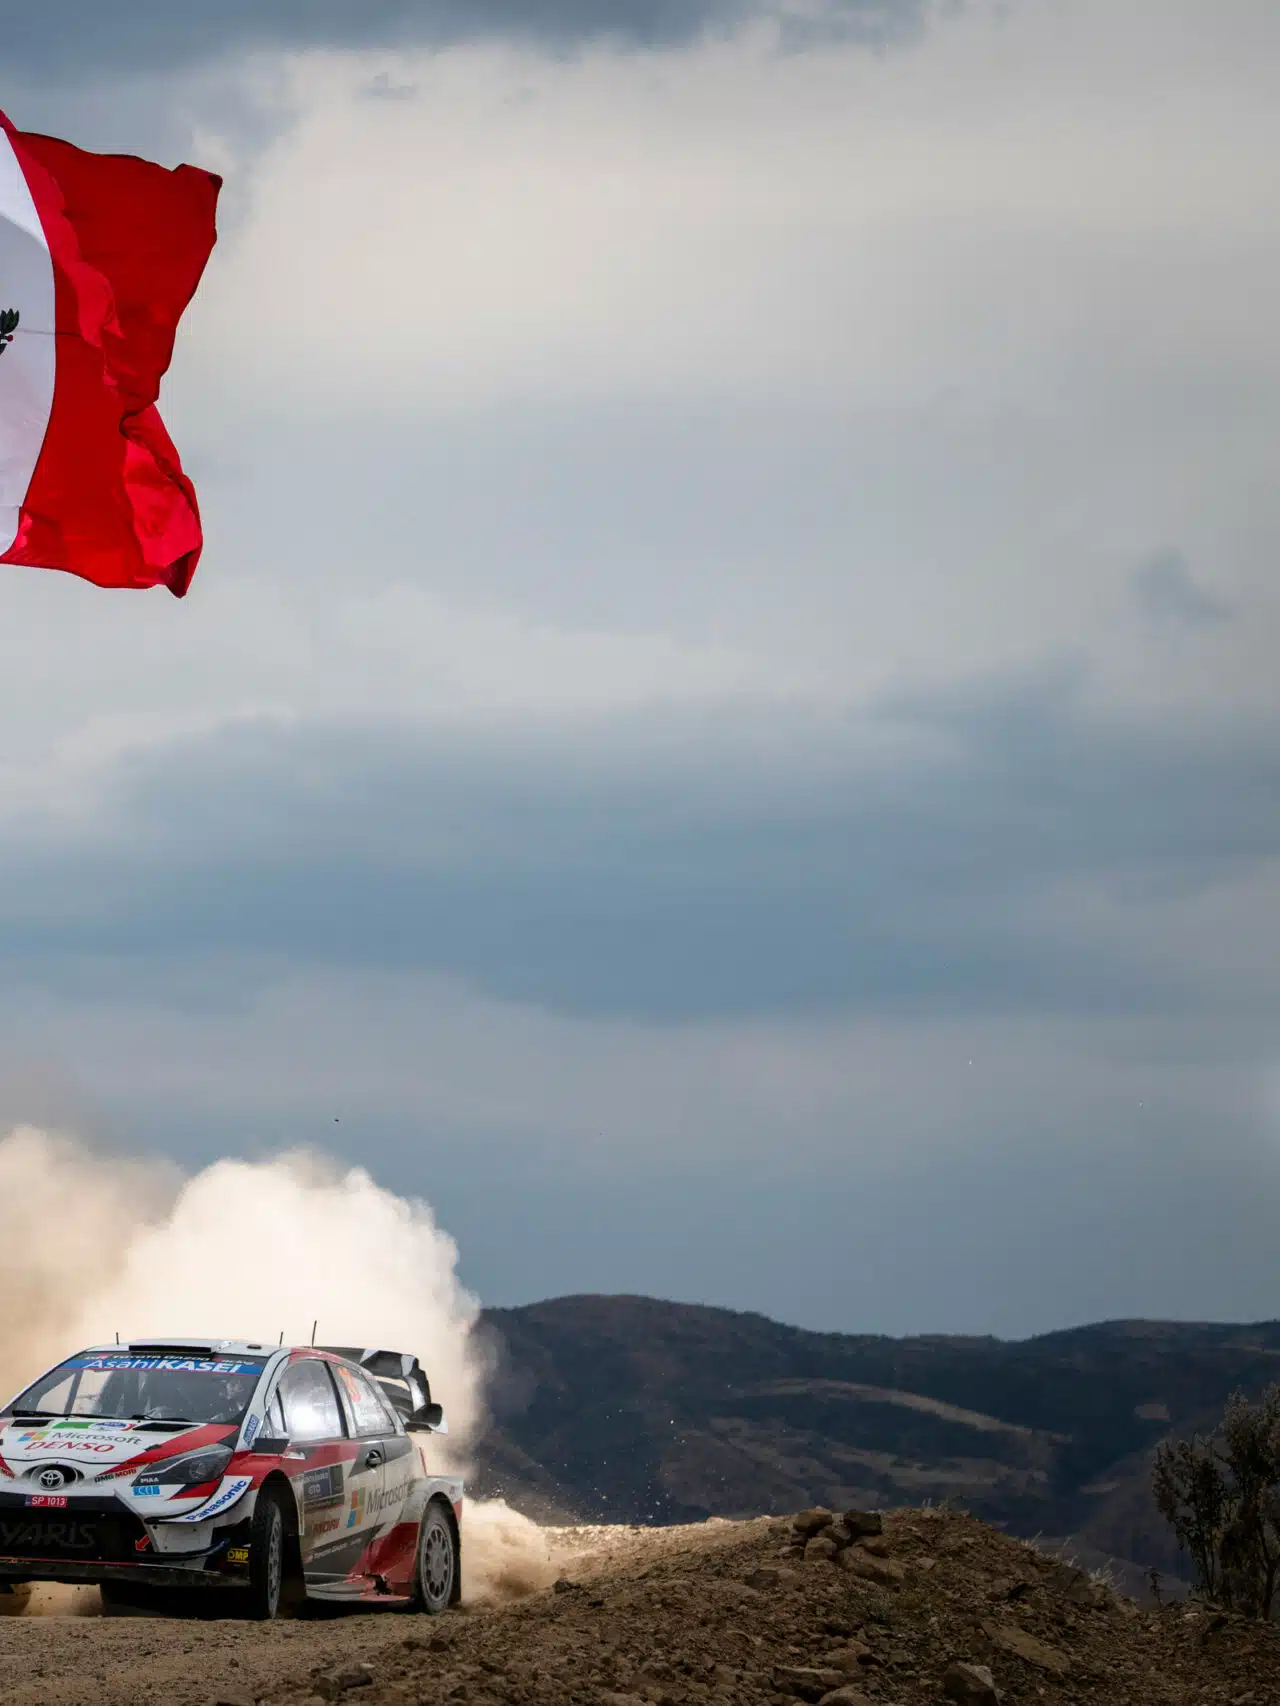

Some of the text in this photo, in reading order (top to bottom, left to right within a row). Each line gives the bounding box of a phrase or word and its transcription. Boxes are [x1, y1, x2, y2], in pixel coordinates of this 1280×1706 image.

[52, 1431, 142, 1445] Microsoft
[24, 1441, 115, 1453] DENSO
[94, 1468, 137, 1483] DMG MORI
[31, 1496, 66, 1506] SP 1013
[185, 1479, 248, 1521] Panasonic
[366, 1476, 416, 1515] Microsoft
[0, 1521, 97, 1548] YARIS
[227, 1549, 249, 1560] OMP
